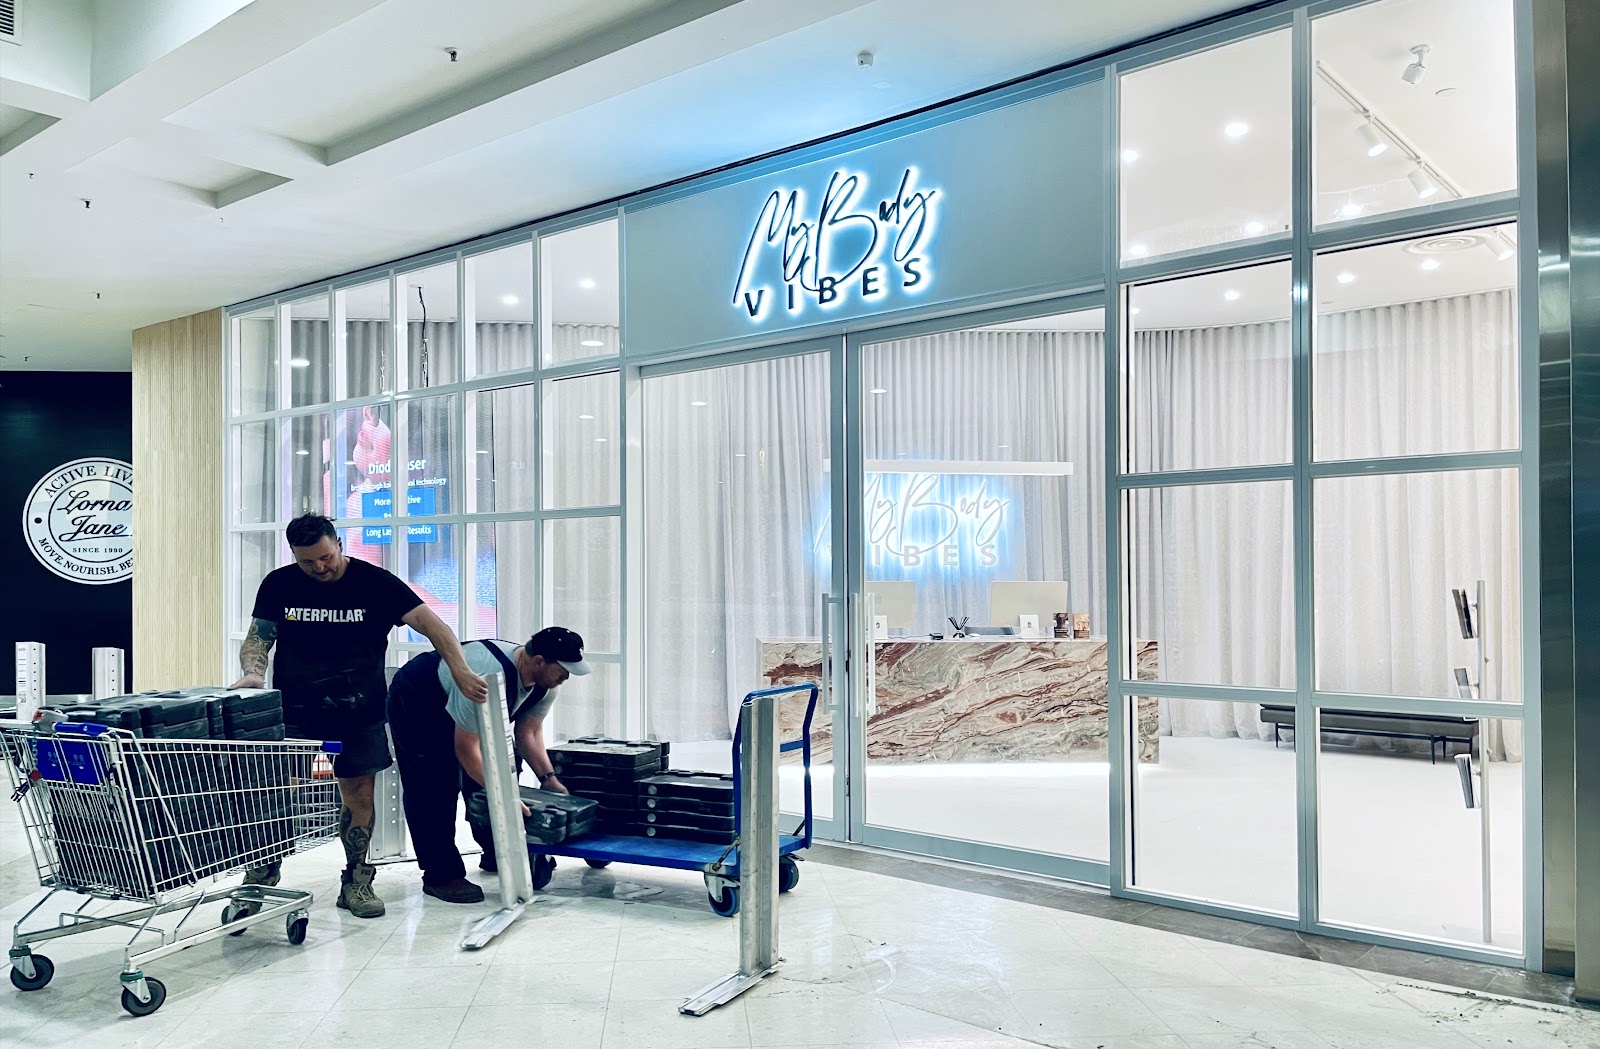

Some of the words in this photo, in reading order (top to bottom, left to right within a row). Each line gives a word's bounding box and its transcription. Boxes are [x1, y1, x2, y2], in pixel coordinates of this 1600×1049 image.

[733, 191, 815, 304] My
[801, 169, 936, 292] Body
[744, 258, 922, 317] VIBES
[368, 460, 391, 475] Diod
[44, 465, 97, 498] ACTIVE
[57, 490, 133, 515] Lorna
[374, 498, 391, 506] More
[58, 514, 133, 542] Jane
[366, 529, 382, 539] Long
[827, 544, 997, 567] IBES
